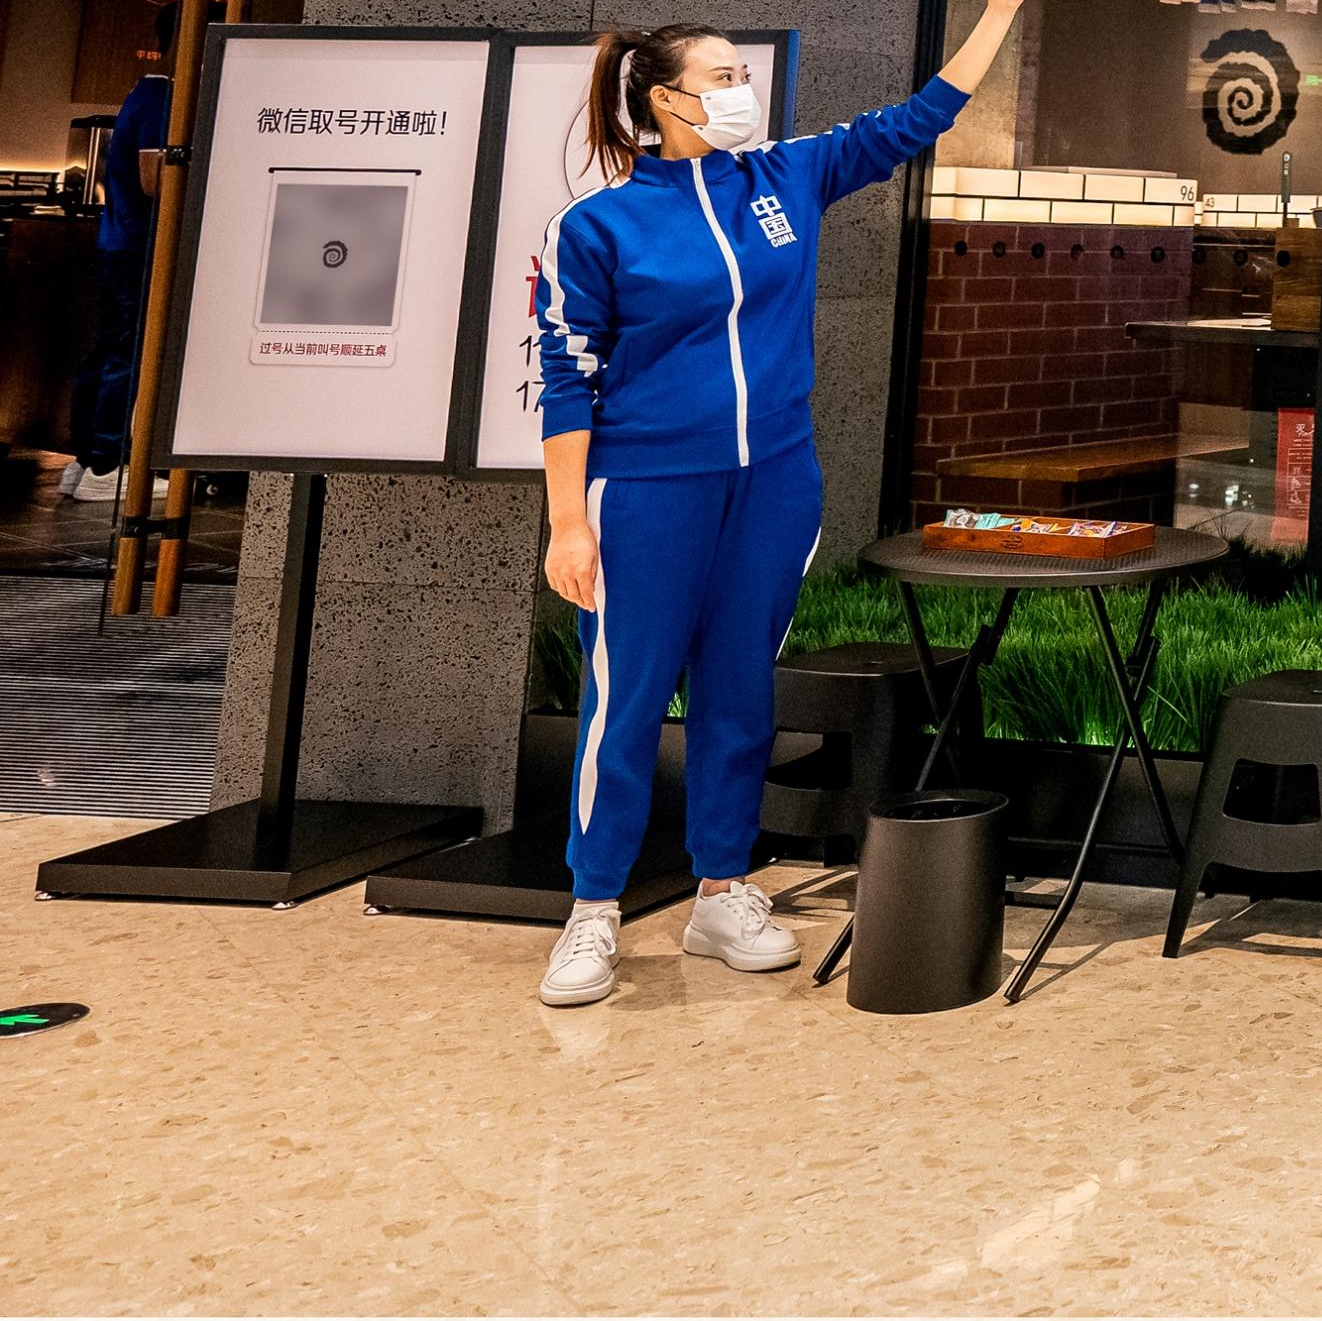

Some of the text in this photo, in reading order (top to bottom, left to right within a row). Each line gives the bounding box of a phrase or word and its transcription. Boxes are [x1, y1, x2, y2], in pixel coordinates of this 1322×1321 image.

[1180, 185, 1194, 202] 96
[750, 194, 793, 240] 中国
[259, 342, 387, 358] 过号从当前叫号顺延五桌
[519, 335, 542, 367] 1
